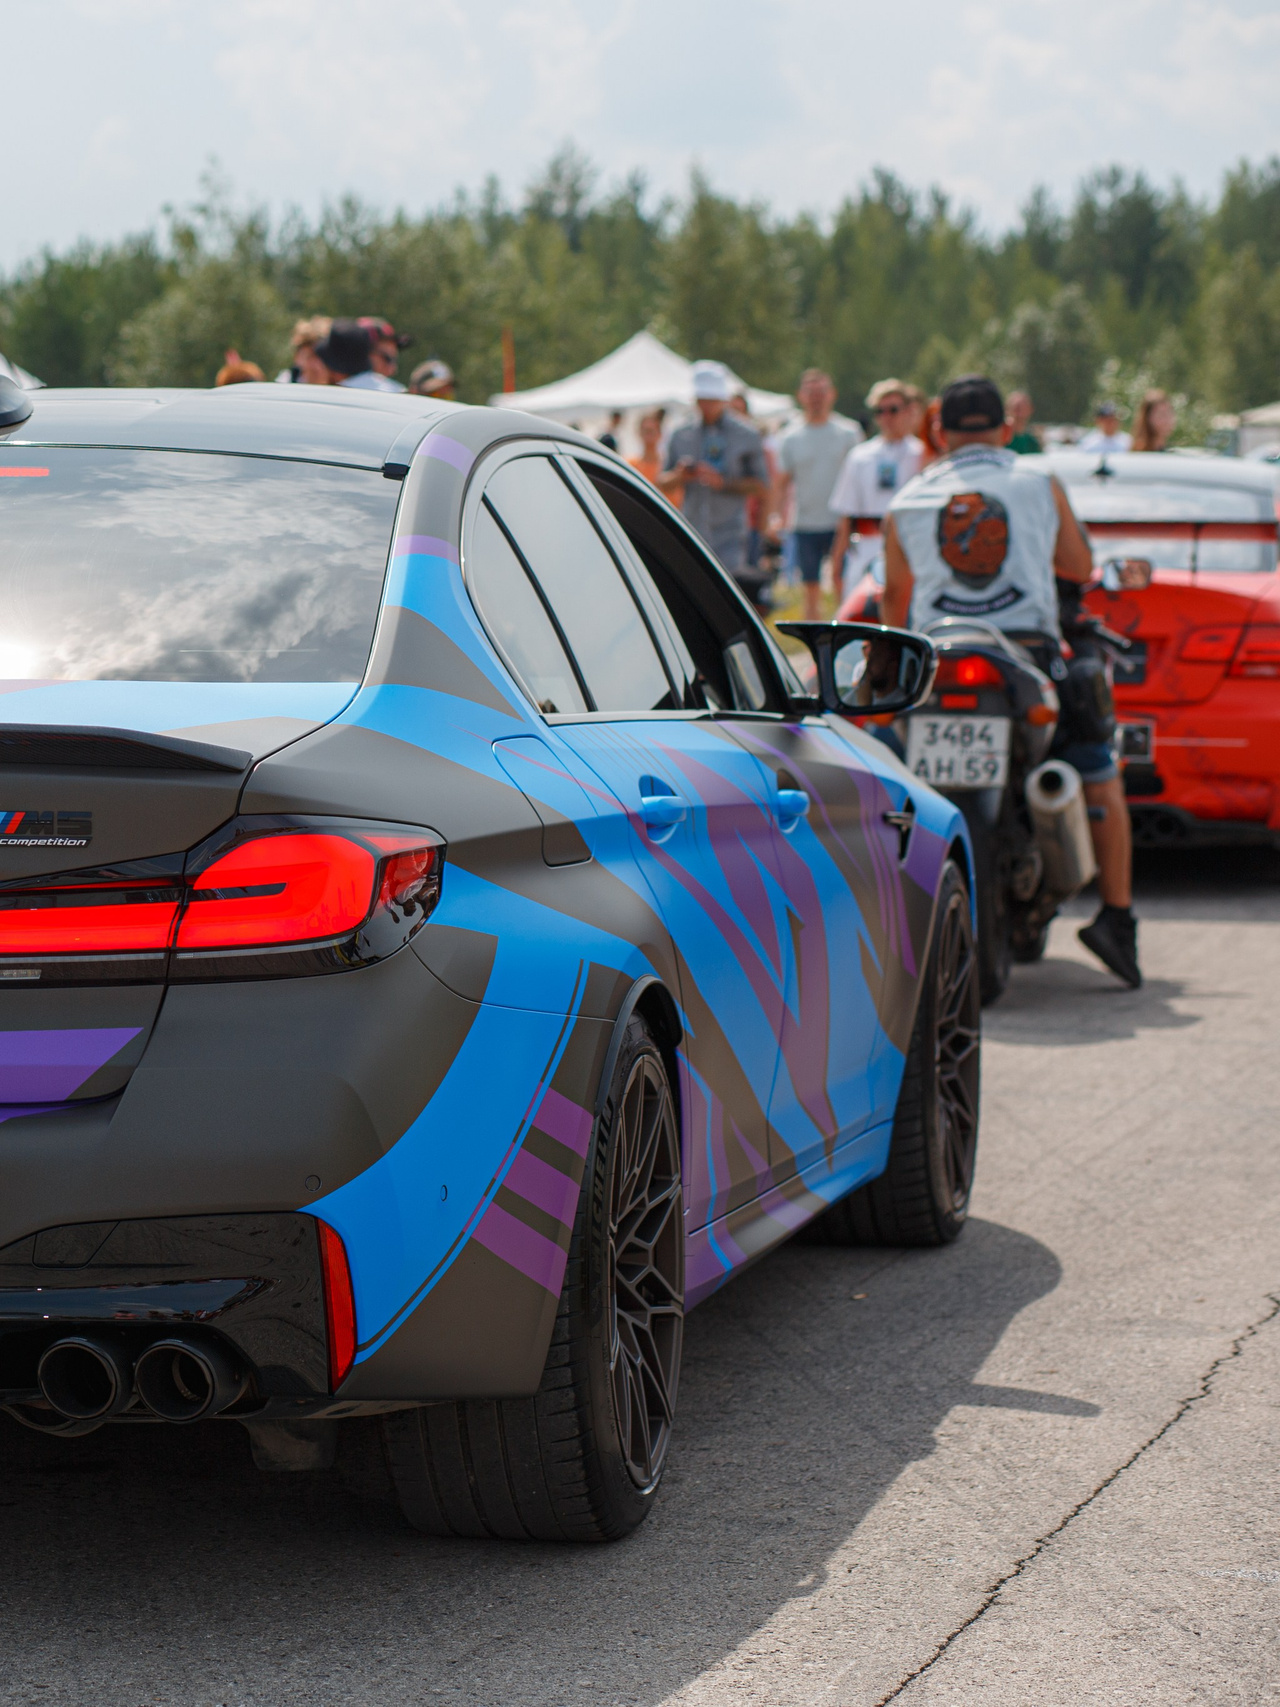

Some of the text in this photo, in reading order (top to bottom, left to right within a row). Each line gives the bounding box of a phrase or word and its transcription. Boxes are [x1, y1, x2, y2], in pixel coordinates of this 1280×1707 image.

[924, 722, 993, 747] 3484
[965, 756, 1000, 781] 59
[591, 1096, 614, 1274] MICHELIN
